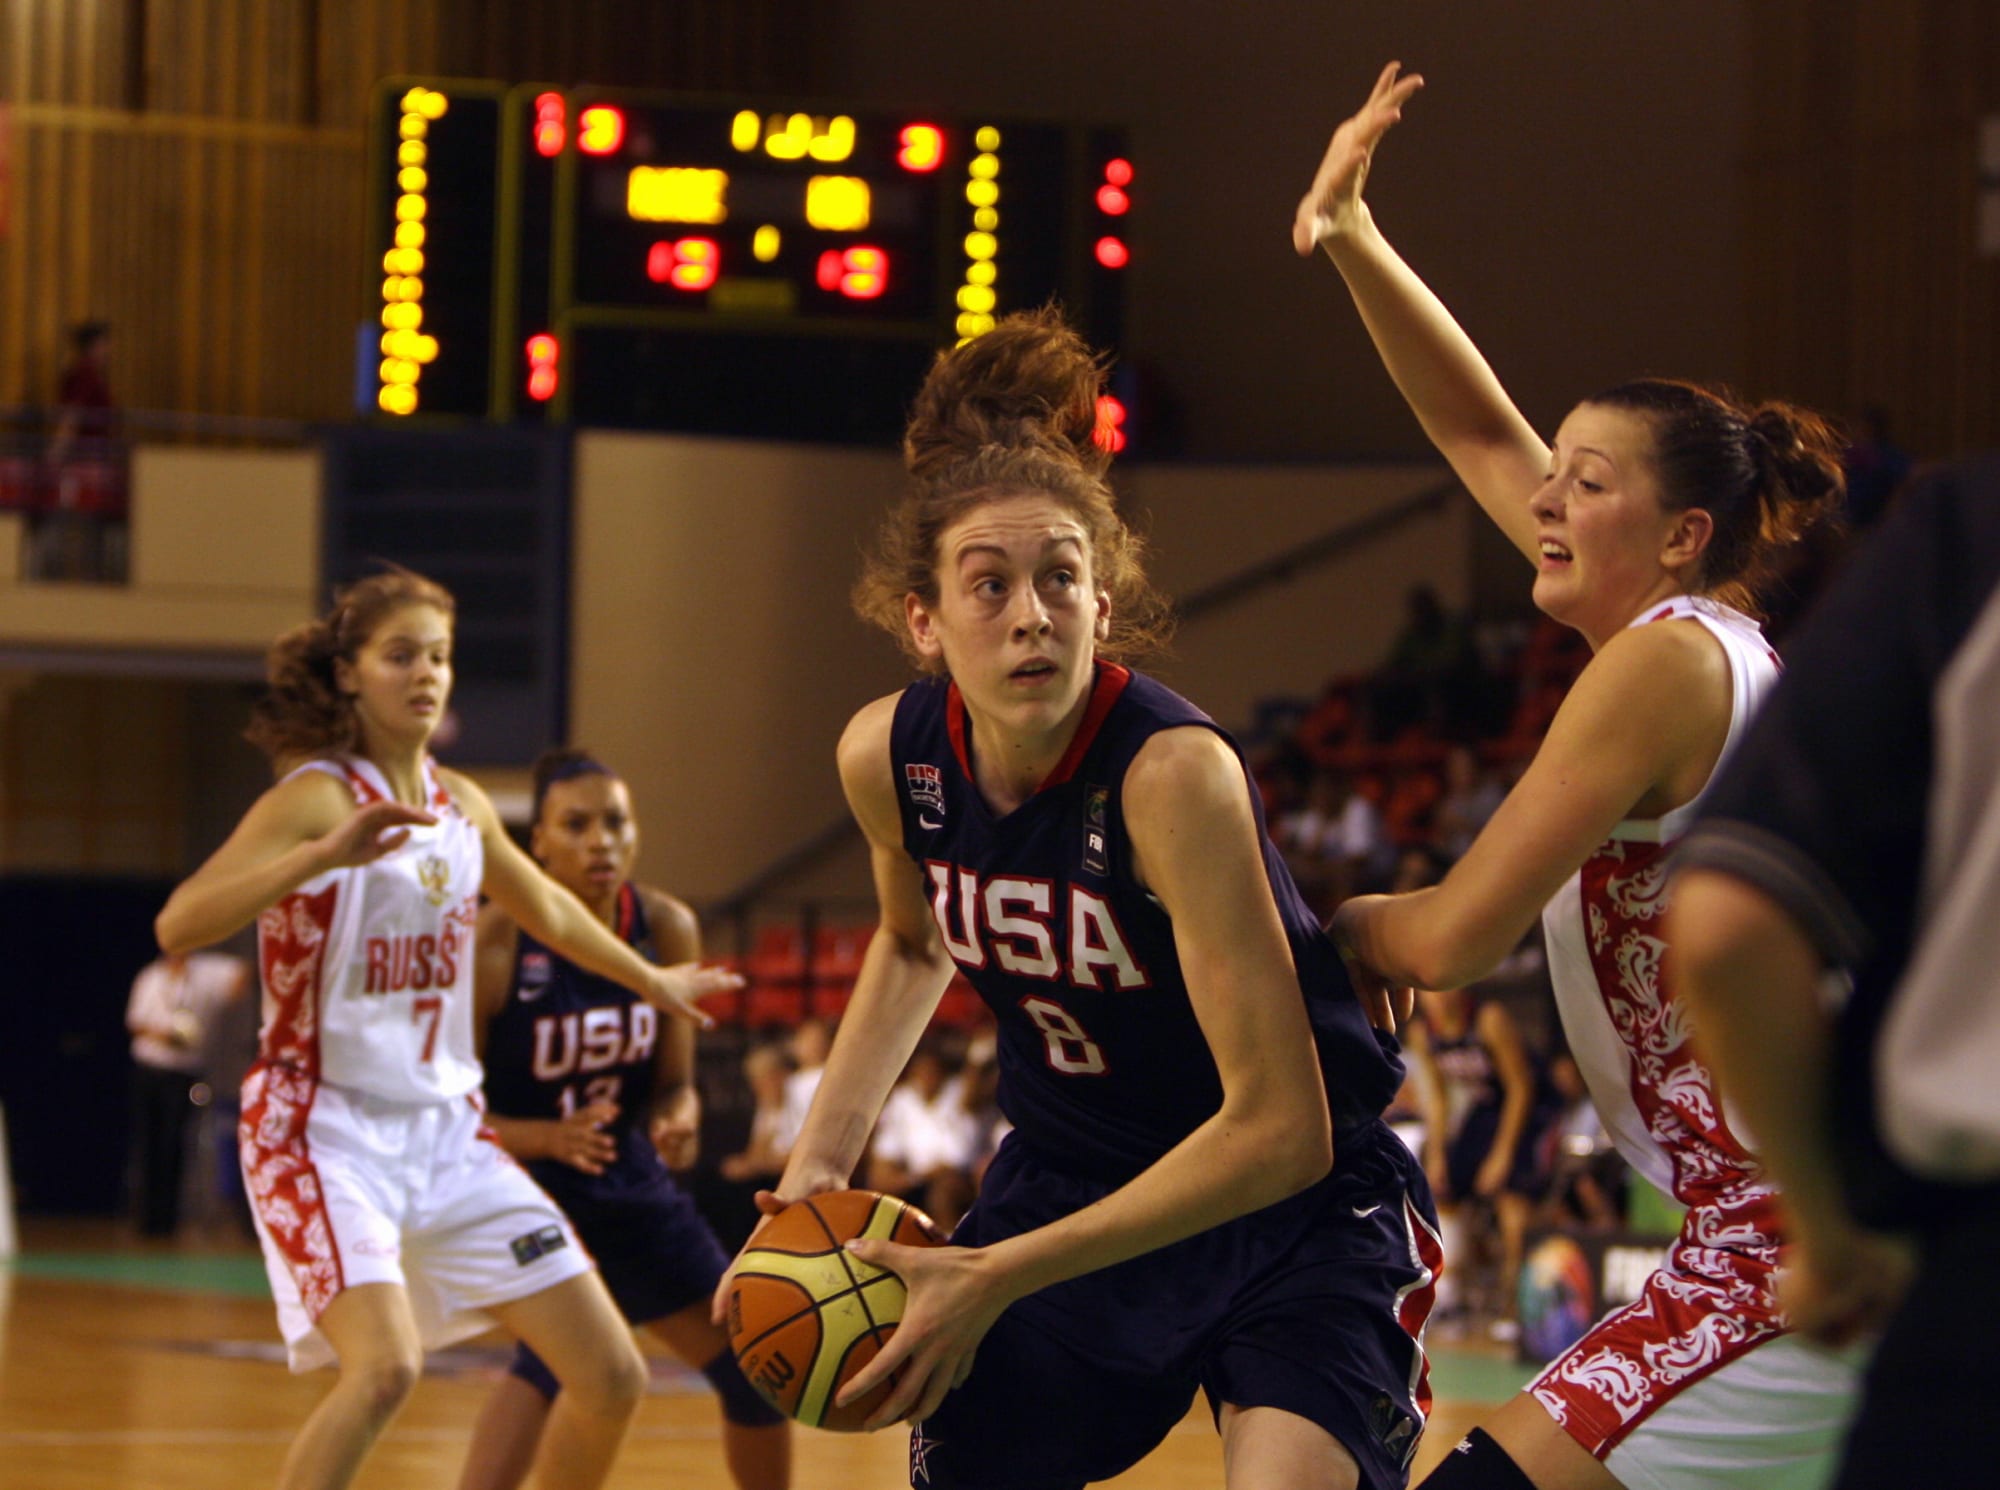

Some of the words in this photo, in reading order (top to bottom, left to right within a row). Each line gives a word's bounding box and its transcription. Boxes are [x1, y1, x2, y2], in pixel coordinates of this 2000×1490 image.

[924, 859, 1151, 991] USA
[412, 996, 443, 1064] 7
[532, 1002, 657, 1081] USA
[1018, 994, 1111, 1076] 8
